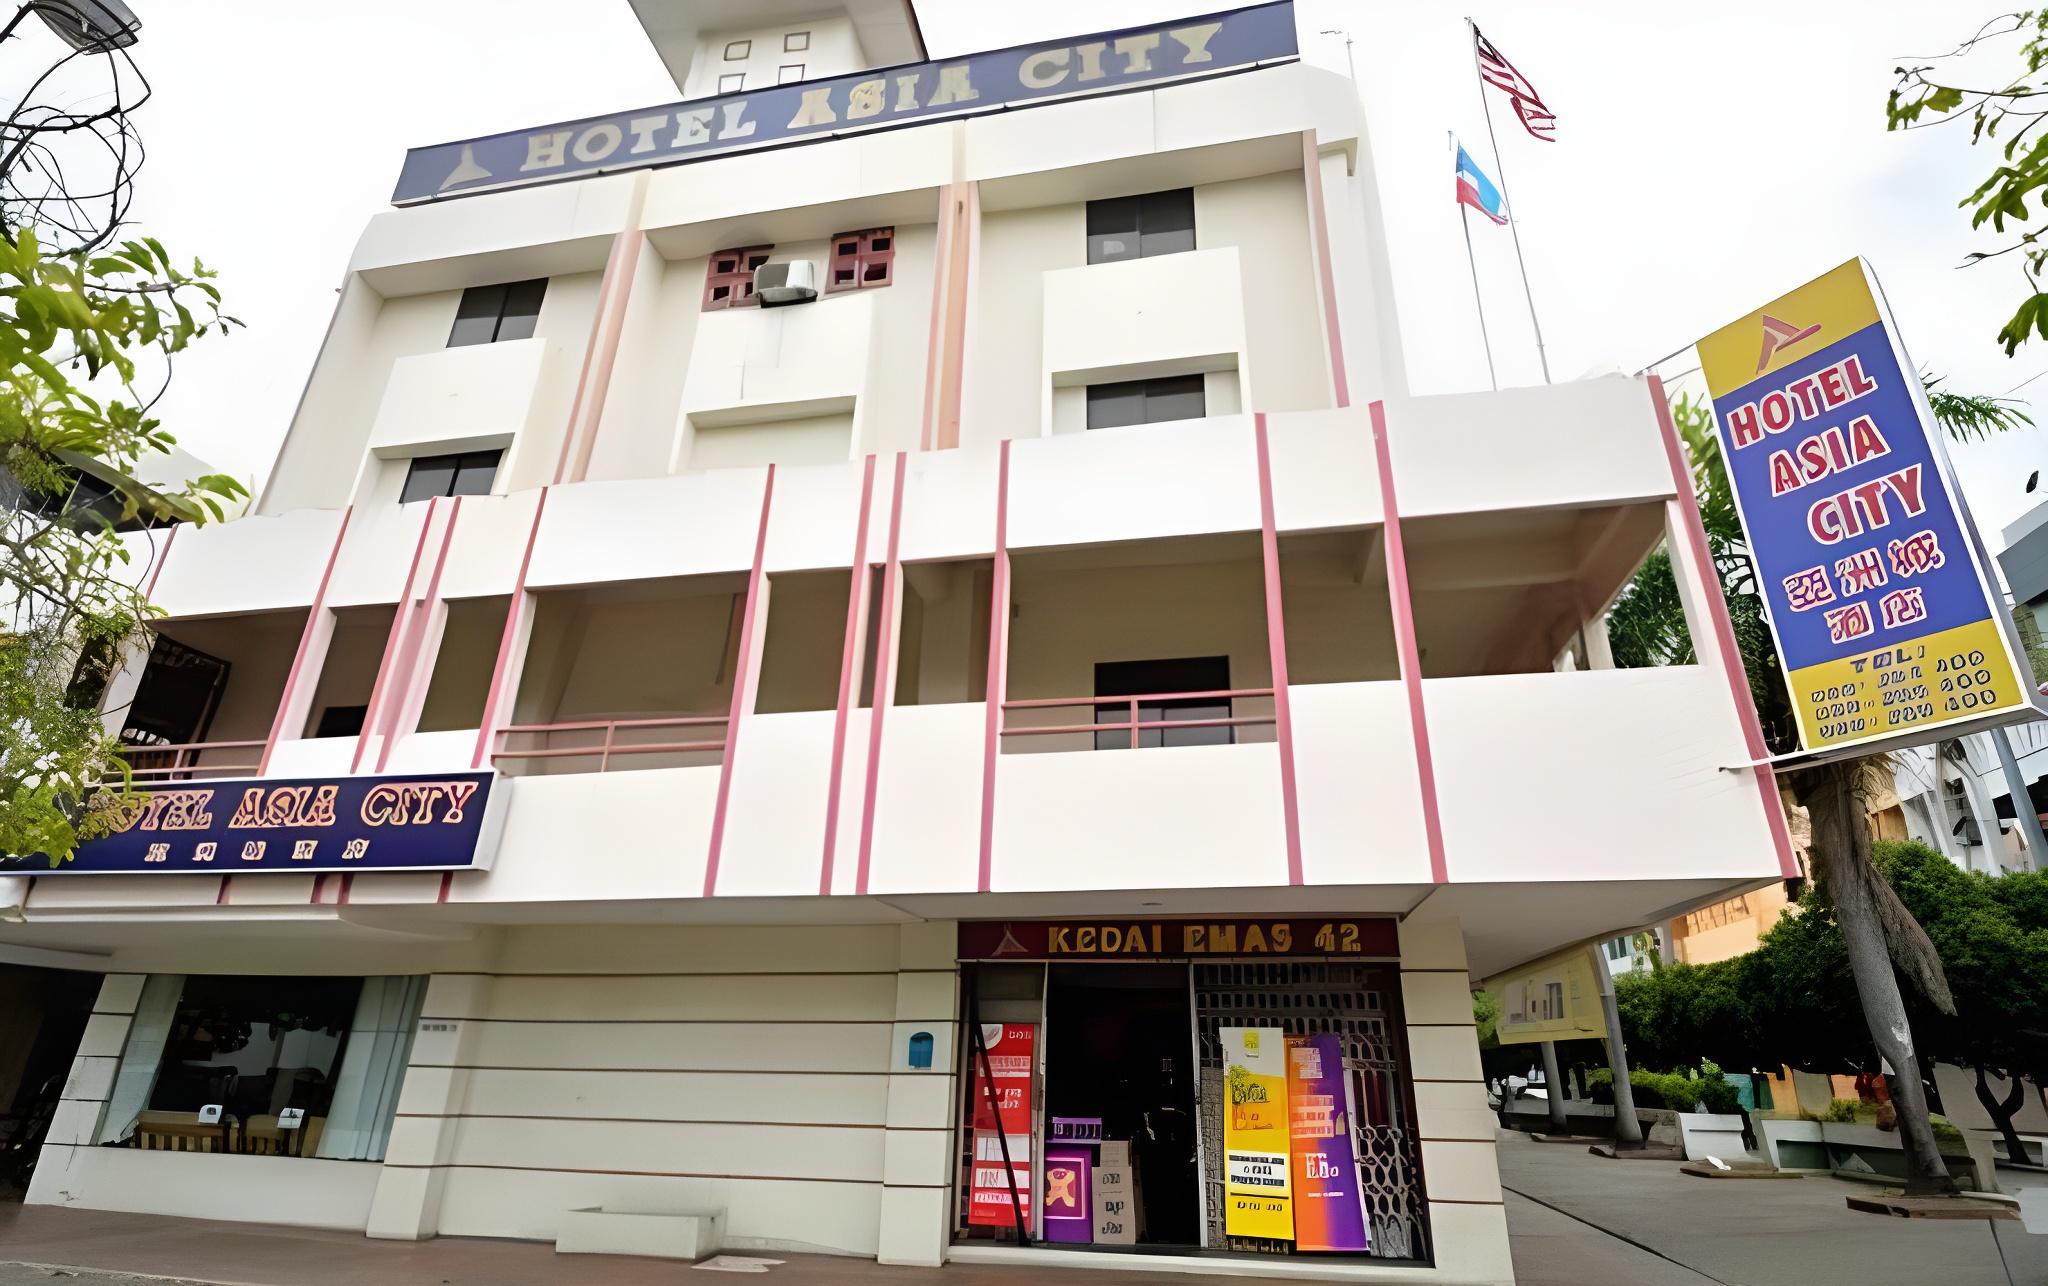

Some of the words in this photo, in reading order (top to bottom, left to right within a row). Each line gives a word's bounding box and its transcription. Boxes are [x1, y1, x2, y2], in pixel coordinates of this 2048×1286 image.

[520, 101, 757, 172] HOTEL
[1018, 22, 1223, 90] CITY
[1726, 354, 1879, 450] HOTEL
[1769, 414, 1892, 497] ASIA
[1807, 463, 1926, 545] CITY
[360, 781, 480, 827] CITY
[1048, 924, 1163, 953] KEDAI
